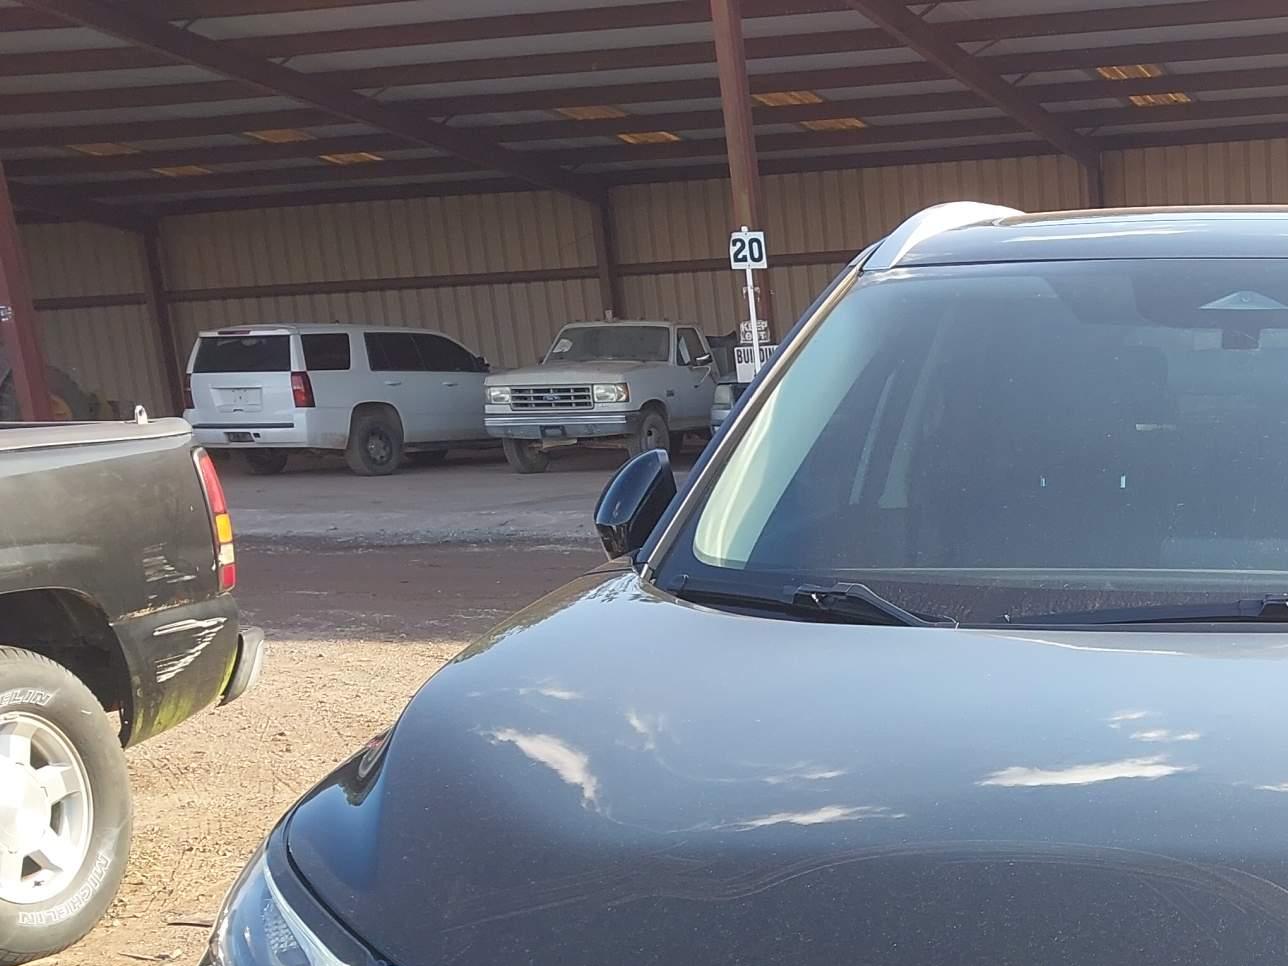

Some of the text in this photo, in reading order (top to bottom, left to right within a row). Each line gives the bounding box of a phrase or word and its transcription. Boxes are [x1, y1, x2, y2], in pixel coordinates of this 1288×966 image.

[732, 237, 763, 263] 20
[736, 347, 778, 364] BUIDIN
[17, 852, 111, 926] MICHELIN
